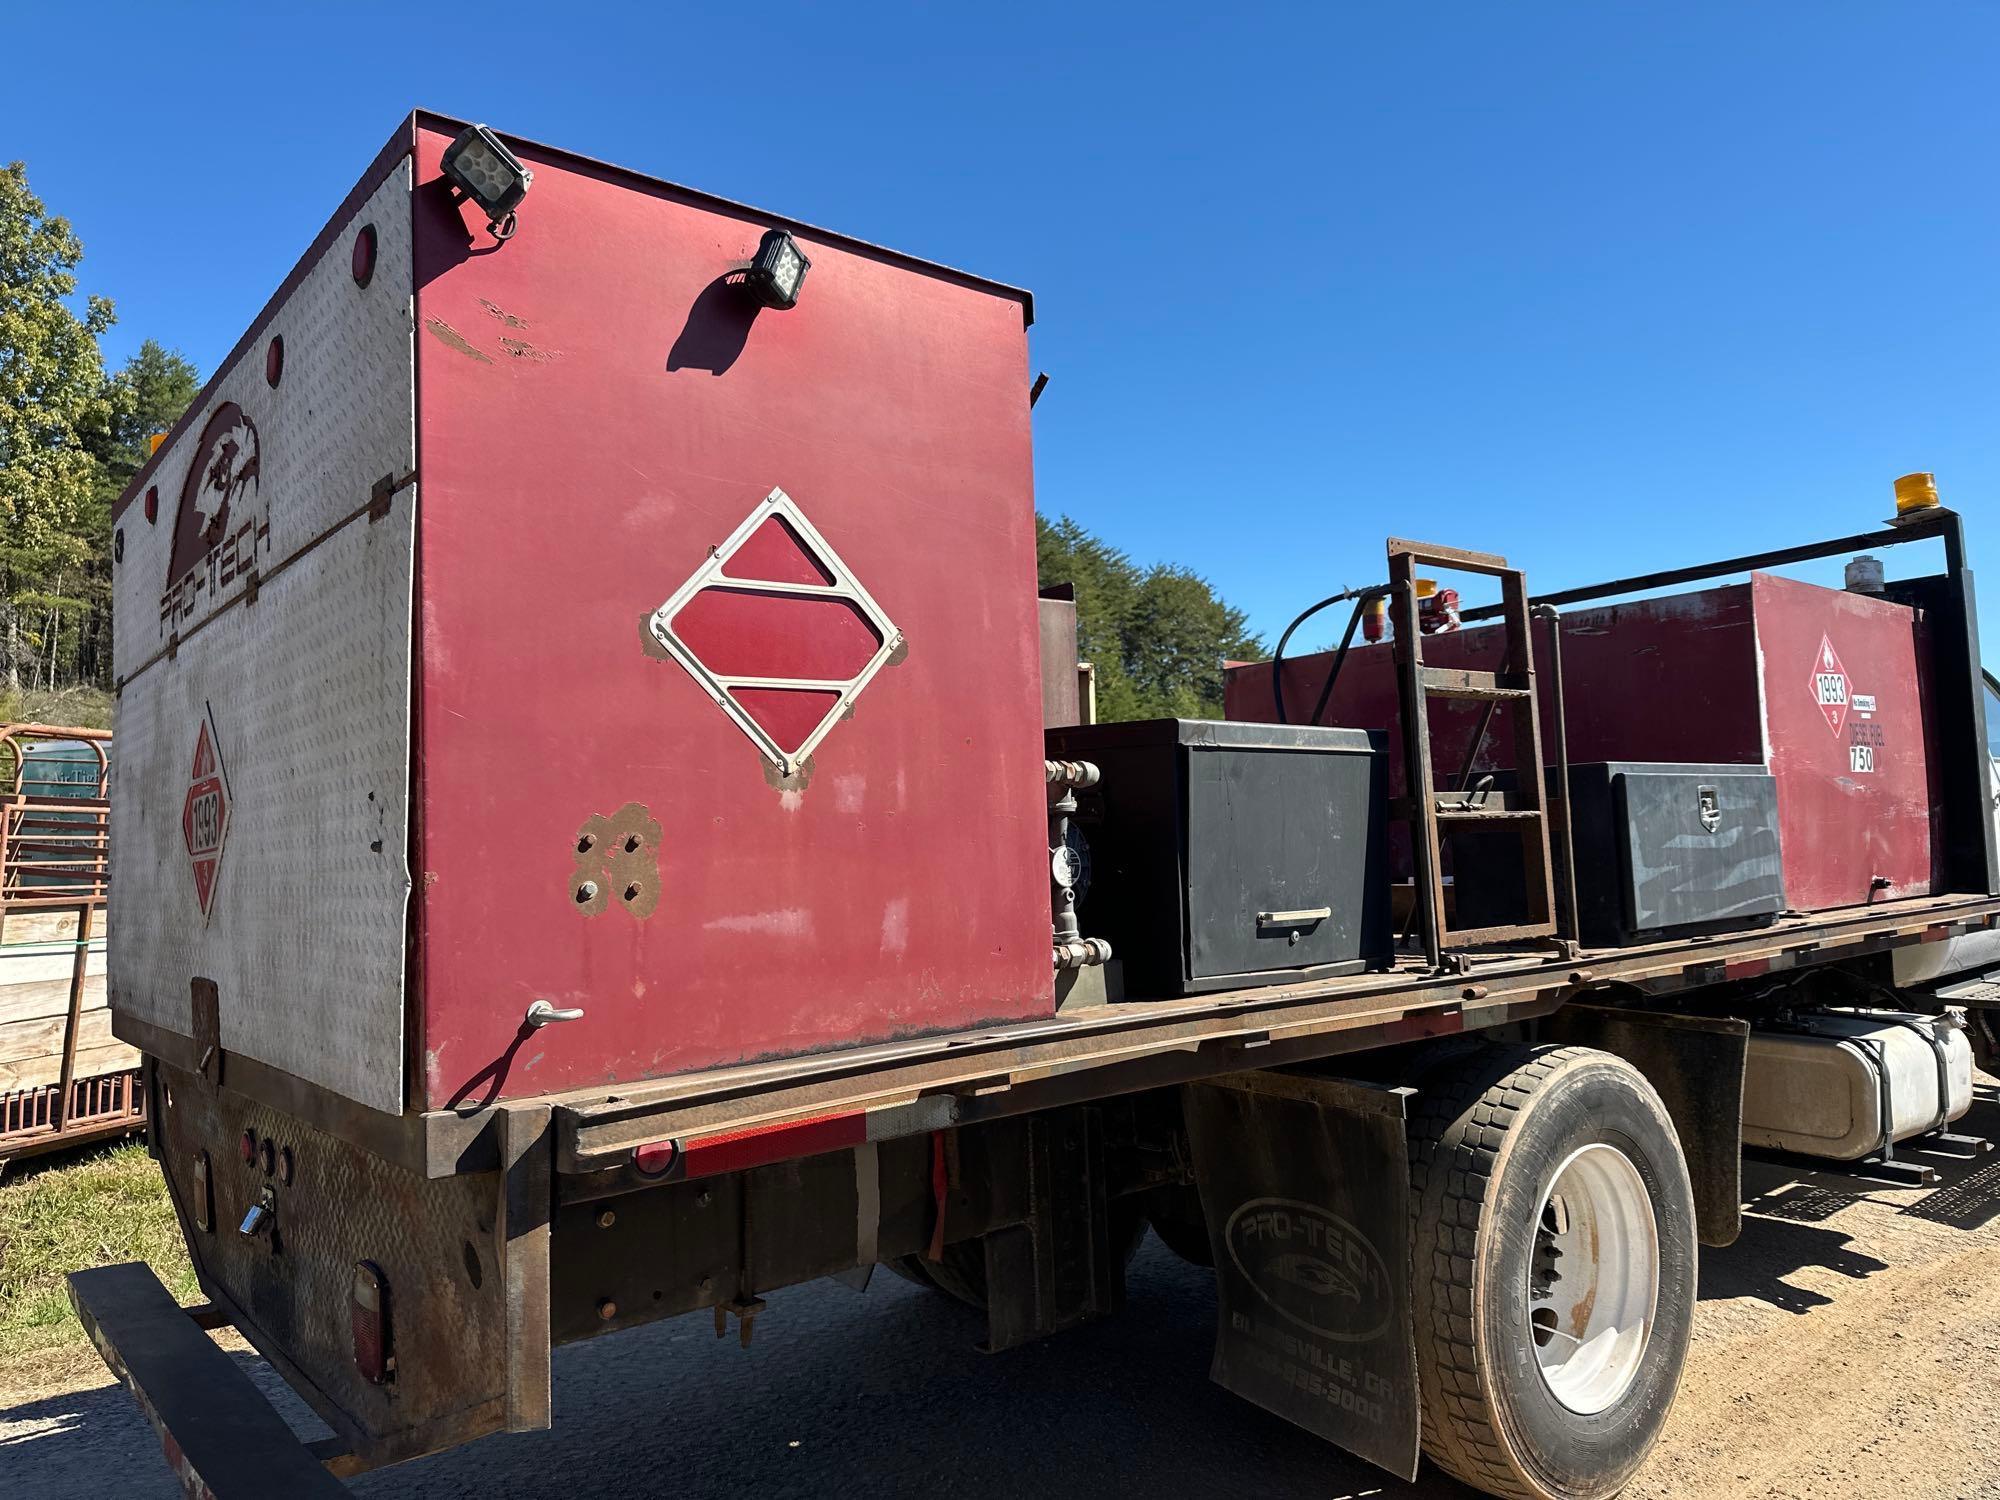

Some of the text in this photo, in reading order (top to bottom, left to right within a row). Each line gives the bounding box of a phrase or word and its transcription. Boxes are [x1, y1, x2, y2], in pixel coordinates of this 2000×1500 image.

[159, 501, 271, 638] PRO-TECH
[1819, 675, 1846, 703] 1993
[1831, 710, 1838, 724] 3
[1851, 747, 1873, 771] 750
[193, 793, 218, 849] 1993
[1240, 1211, 1380, 1299] PRO-TECH
